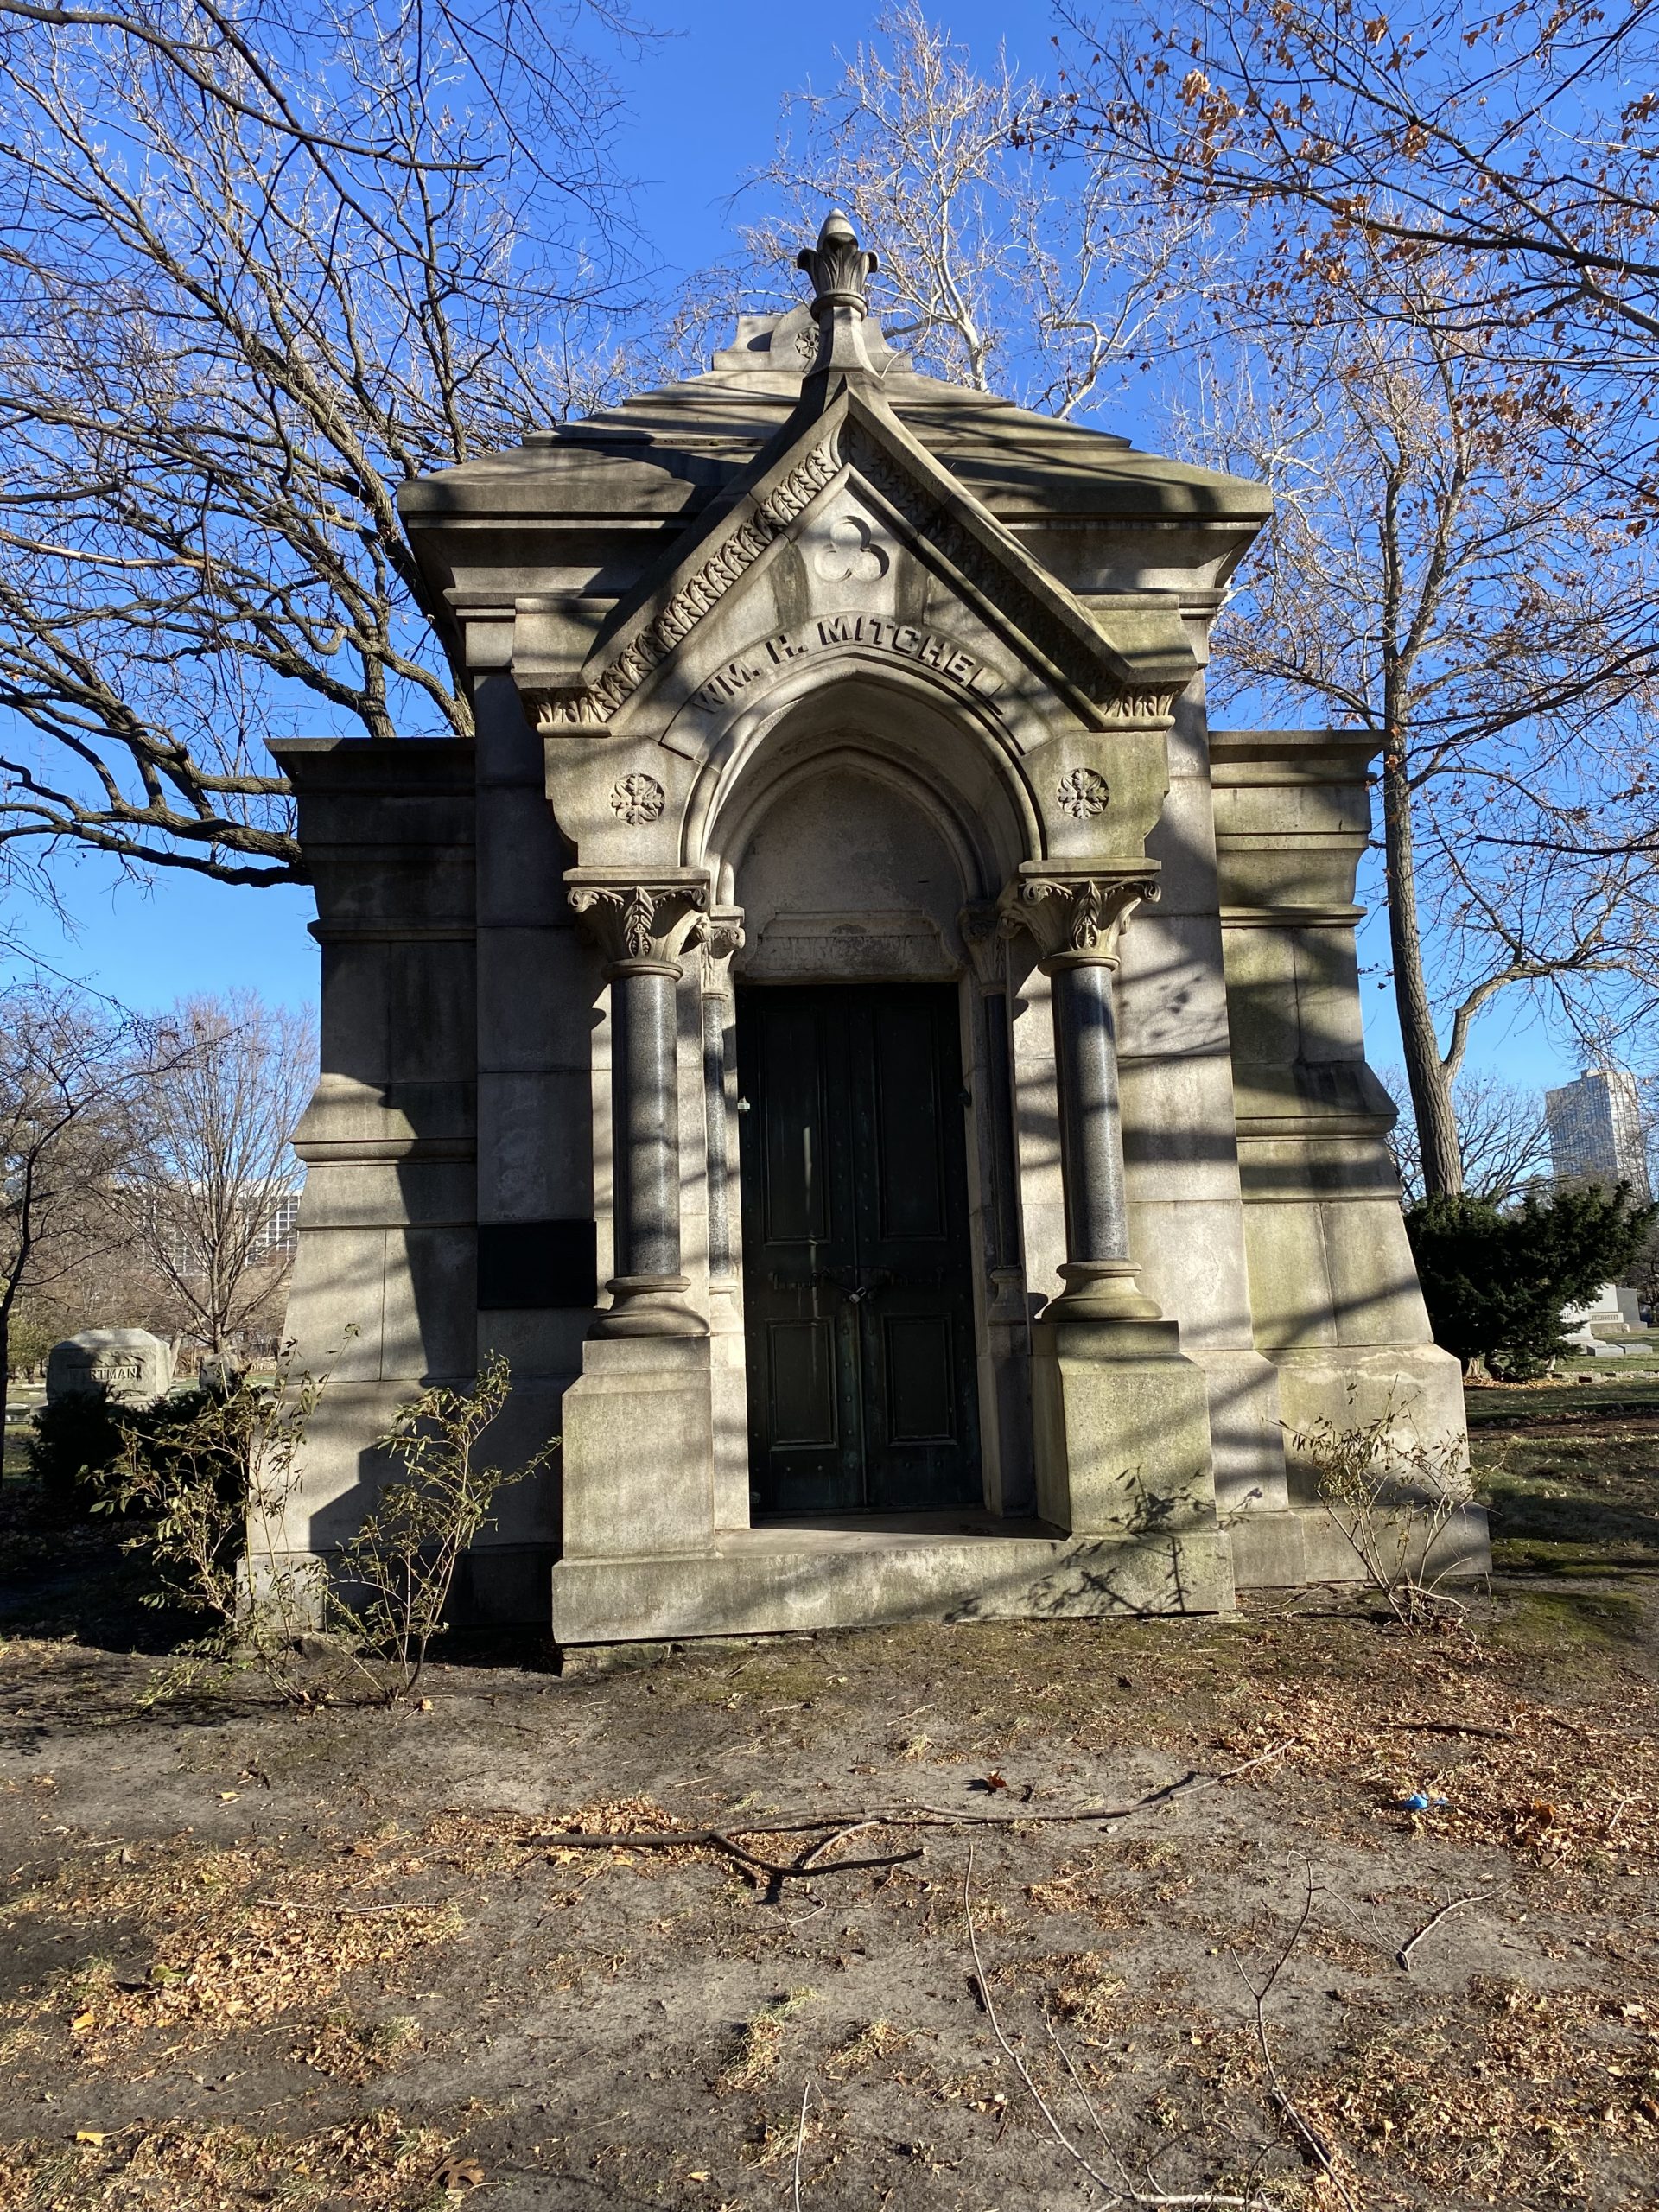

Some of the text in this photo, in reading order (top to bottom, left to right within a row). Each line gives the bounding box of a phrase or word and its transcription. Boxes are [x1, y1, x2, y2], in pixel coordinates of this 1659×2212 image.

[692, 659, 763, 715] WM.
[765, 634, 809, 665] H.
[69, 1368, 137, 1380] RTMAN
